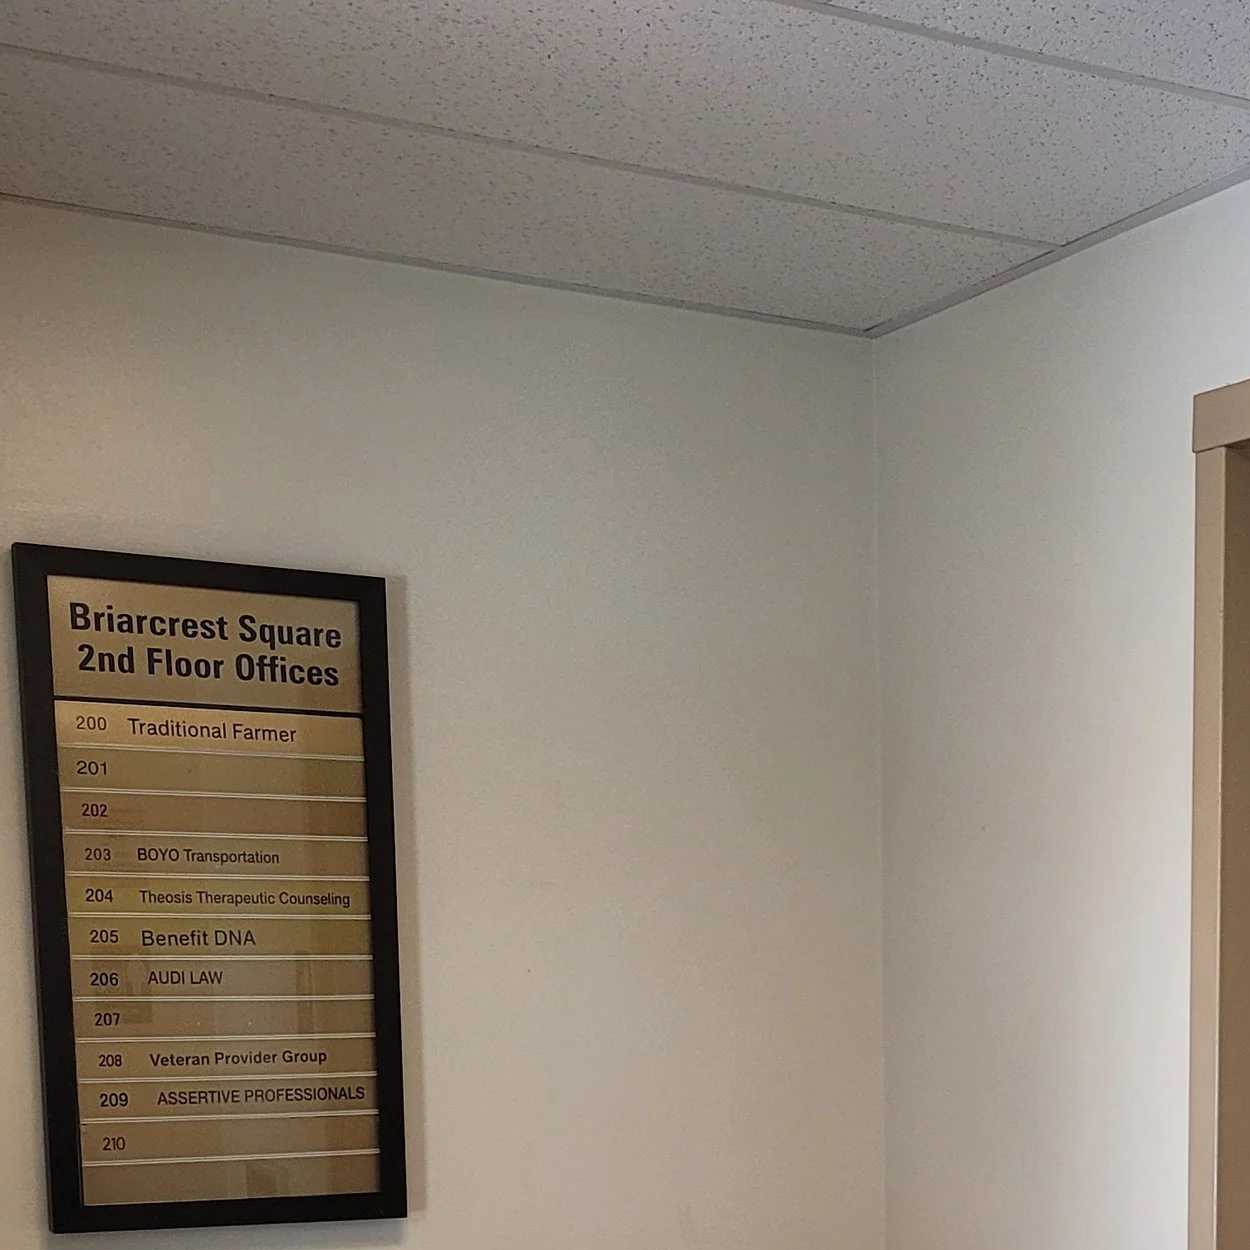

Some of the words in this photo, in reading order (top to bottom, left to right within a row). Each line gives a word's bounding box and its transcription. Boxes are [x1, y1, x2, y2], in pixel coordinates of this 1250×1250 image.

[69, 602, 229, 641] Briarcrest
[238, 614, 342, 649] Square
[78, 644, 135, 674] 2nd
[147, 648, 224, 679] Floor
[236, 653, 340, 686] Offices
[76, 716, 107, 731] 200
[127, 718, 227, 739] Traditional
[232, 724, 297, 743] Farmer
[76, 761, 108, 775] 201
[81, 803, 109, 817] 202
[84, 848, 111, 862] 203
[137, 848, 180, 862] BOYO
[184, 849, 280, 866] Transportation
[85, 889, 114, 903] 204
[139, 890, 193, 904] Theosis
[196, 891, 275, 906] Therapeutic
[279, 892, 350, 908] Counseling
[90, 929, 119, 943] 205
[141, 930, 208, 946] Benefit
[214, 930, 256, 946] DNA
[90, 973, 119, 987] 206
[148, 971, 186, 985] AUDI
[190, 971, 223, 985] LAW
[94, 1013, 121, 1026] 207
[99, 1054, 123, 1067] 208
[150, 1053, 210, 1067] Veteran
[214, 1051, 277, 1065] Provider
[282, 1050, 327, 1066] Group
[100, 1093, 129, 1107] 209
[157, 1090, 240, 1105] ASSERTIVE
[244, 1086, 365, 1103] PROFESSIONALS
[102, 1137, 125, 1151] 210
